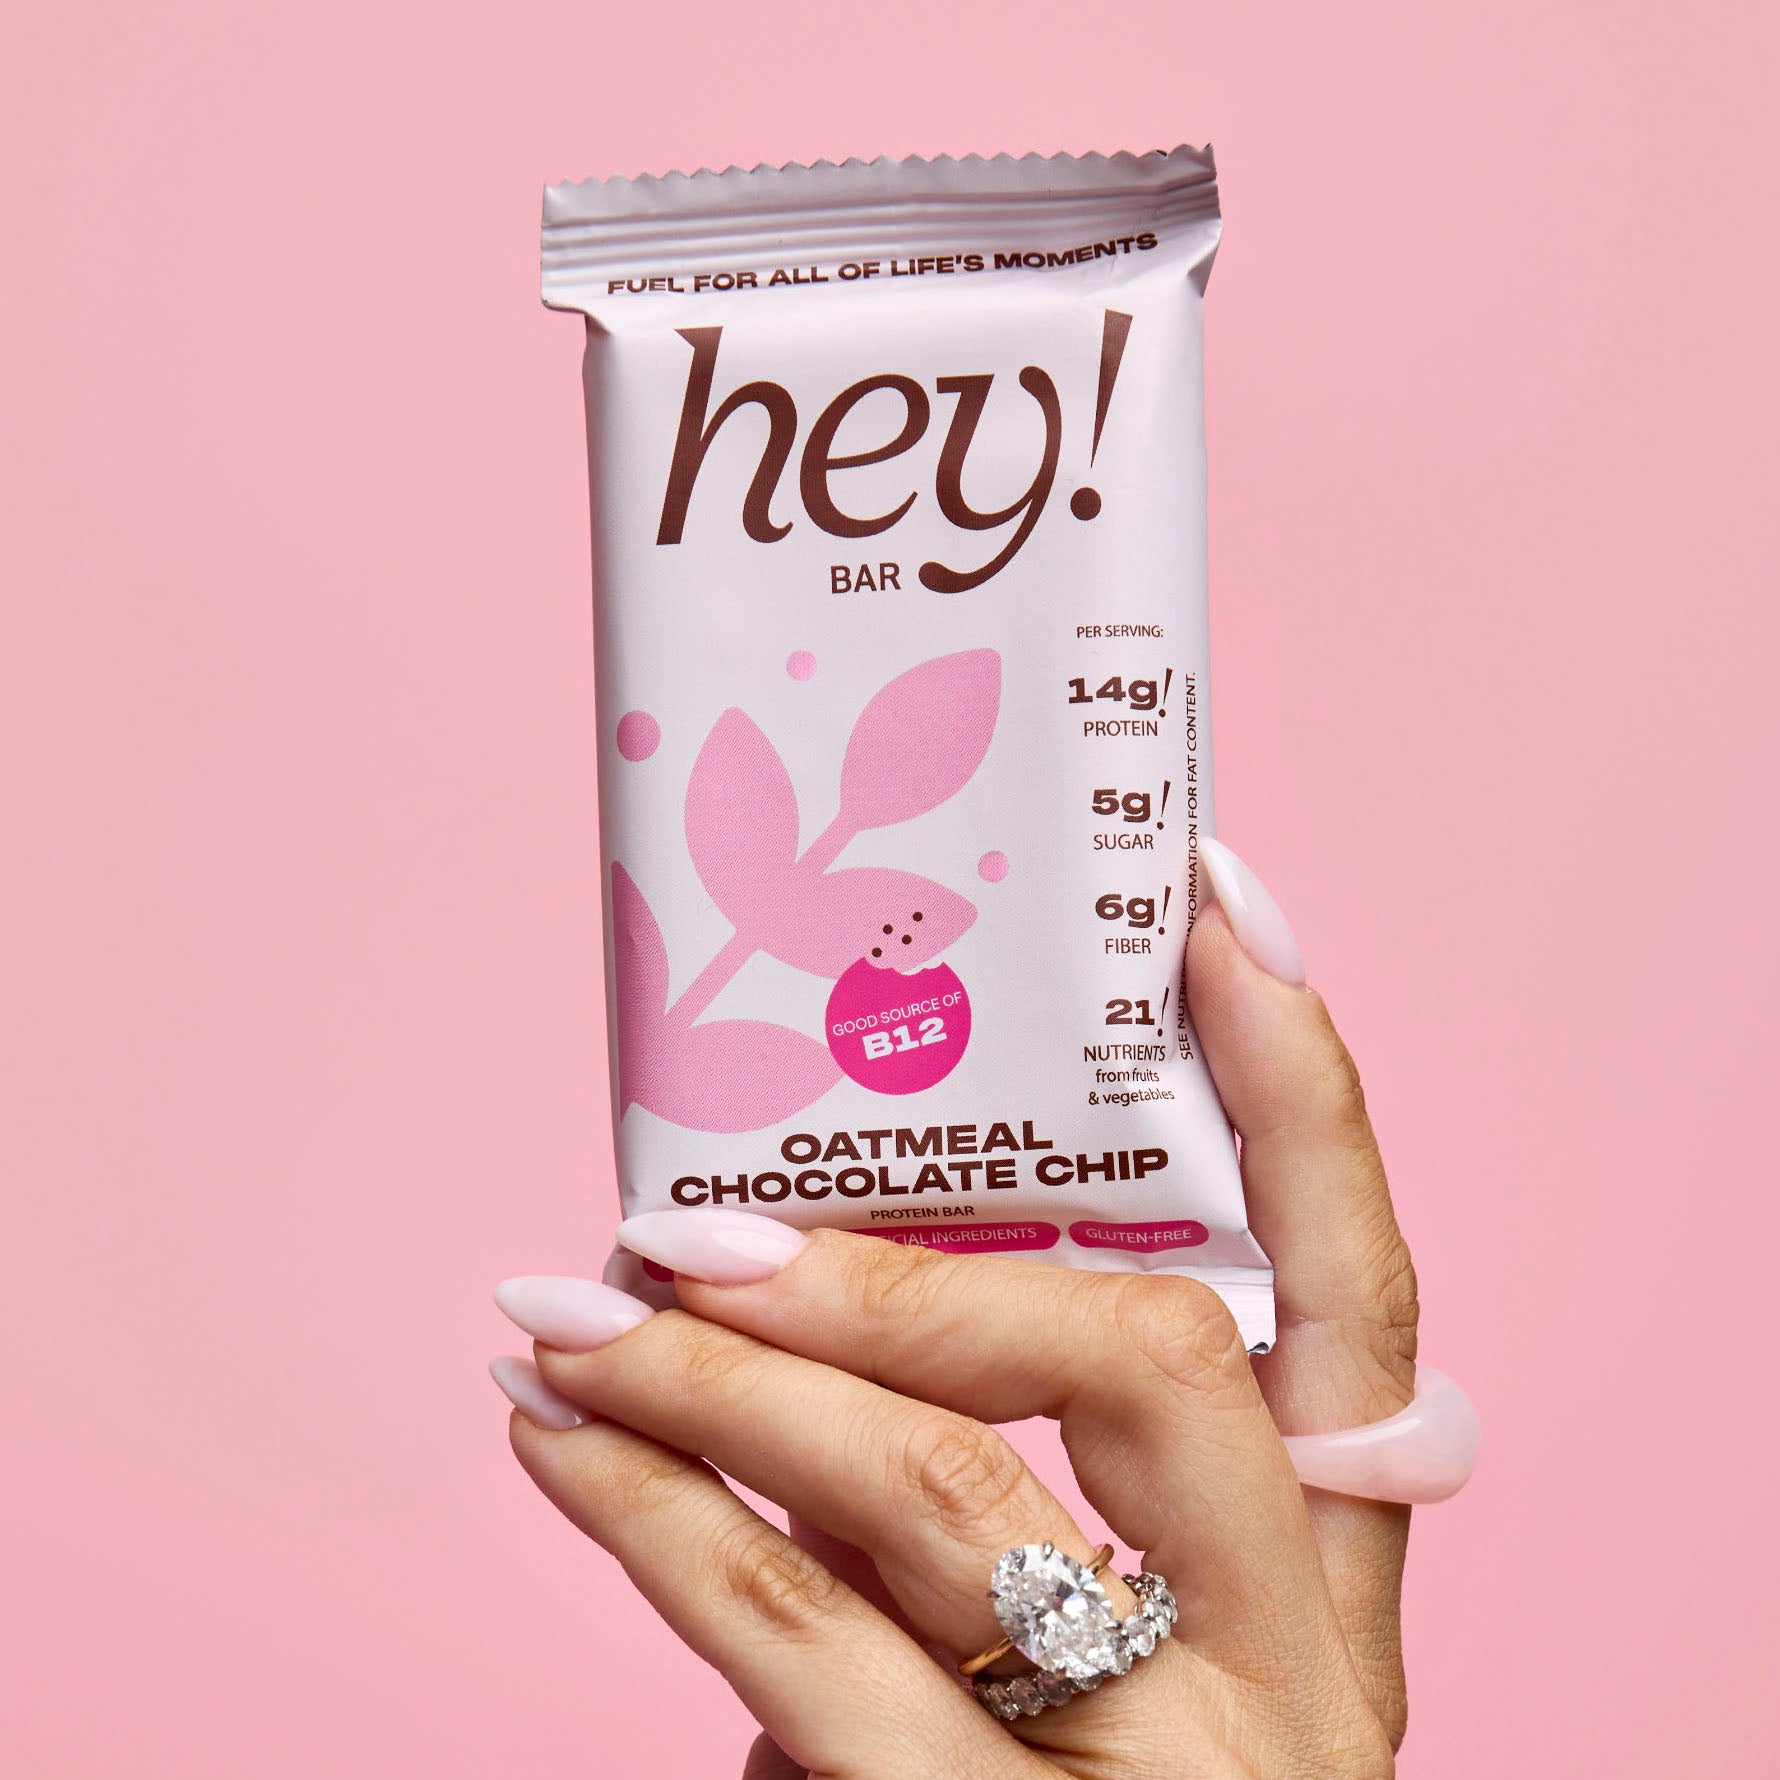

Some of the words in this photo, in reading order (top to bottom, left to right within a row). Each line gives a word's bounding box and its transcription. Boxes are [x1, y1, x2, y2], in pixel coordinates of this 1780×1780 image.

[608, 277, 684, 294] FUEL
[694, 272, 758, 292] FOR
[769, 267, 829, 286] ALL
[838, 262, 880, 280] OF
[891, 255, 984, 276] LIFE'S
[994, 233, 1158, 269] MOMENTS
[656, 309, 1133, 594] hey!
[831, 563, 901, 594] BAR
[1077, 626, 1101, 638] PER
[1105, 625, 1163, 637] SERVING:
[1069, 668, 1172, 717] 14g!
[1186, 672, 1197, 752] CONTENT.
[1084, 720, 1158, 737] PROTEIN
[1187, 753, 1197, 783] FAT
[1092, 780, 1170, 830] 5g!
[1188, 787, 1197, 818] FOR
[1094, 834, 1153, 850] SUGAR
[1187, 823, 1198, 937] NFORMATION
[1095, 886, 1171, 935] 6g!
[1106, 938, 1151, 954] FIBER
[833, 1015, 878, 1036] GOOD
[881, 998, 940, 1024] SOURCE
[943, 992, 962, 1007] OF
[1106, 987, 1169, 1037] 21!
[862, 1017, 947, 1060] B12
[1084, 1045, 1166, 1062] NUTRIENTS
[1178, 1033, 1194, 1060] SEE
[1096, 1069, 1129, 1083] from
[1132, 1068, 1159, 1081] fruits
[1089, 1092, 1099, 1105] &
[1103, 1089, 1174, 1106] vegetables
[780, 1120, 1053, 1163] OATMEAL
[670, 1158, 1017, 1207] CHOCOLATE
[1035, 1147, 1169, 1184] CHIP
[870, 1207, 939, 1220] PROTEIN
[943, 1205, 975, 1217] BAR
[932, 1228, 1036, 1244] INGREDIENTS
[1087, 1229, 1192, 1243] GLUTEN-FREE
